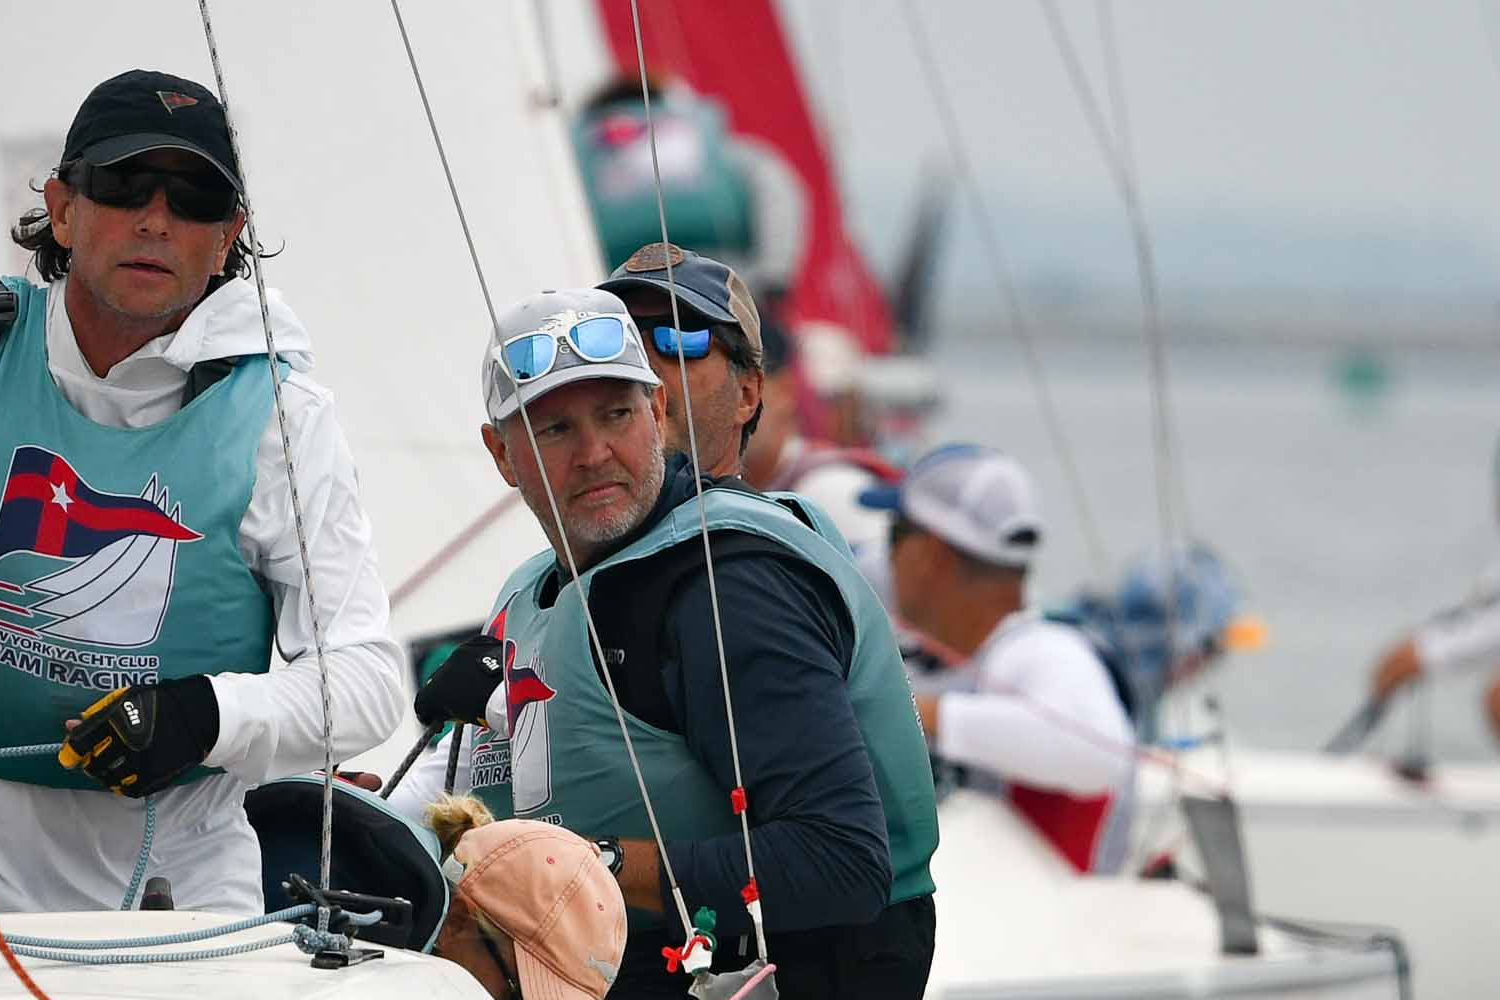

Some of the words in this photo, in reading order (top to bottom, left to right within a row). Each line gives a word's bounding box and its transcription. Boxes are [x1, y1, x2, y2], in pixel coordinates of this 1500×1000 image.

[11, 633, 53, 658] YORK
[53, 646, 116, 668] YACHT
[117, 655, 160, 669] CLUB
[47, 660, 159, 691] RACING
